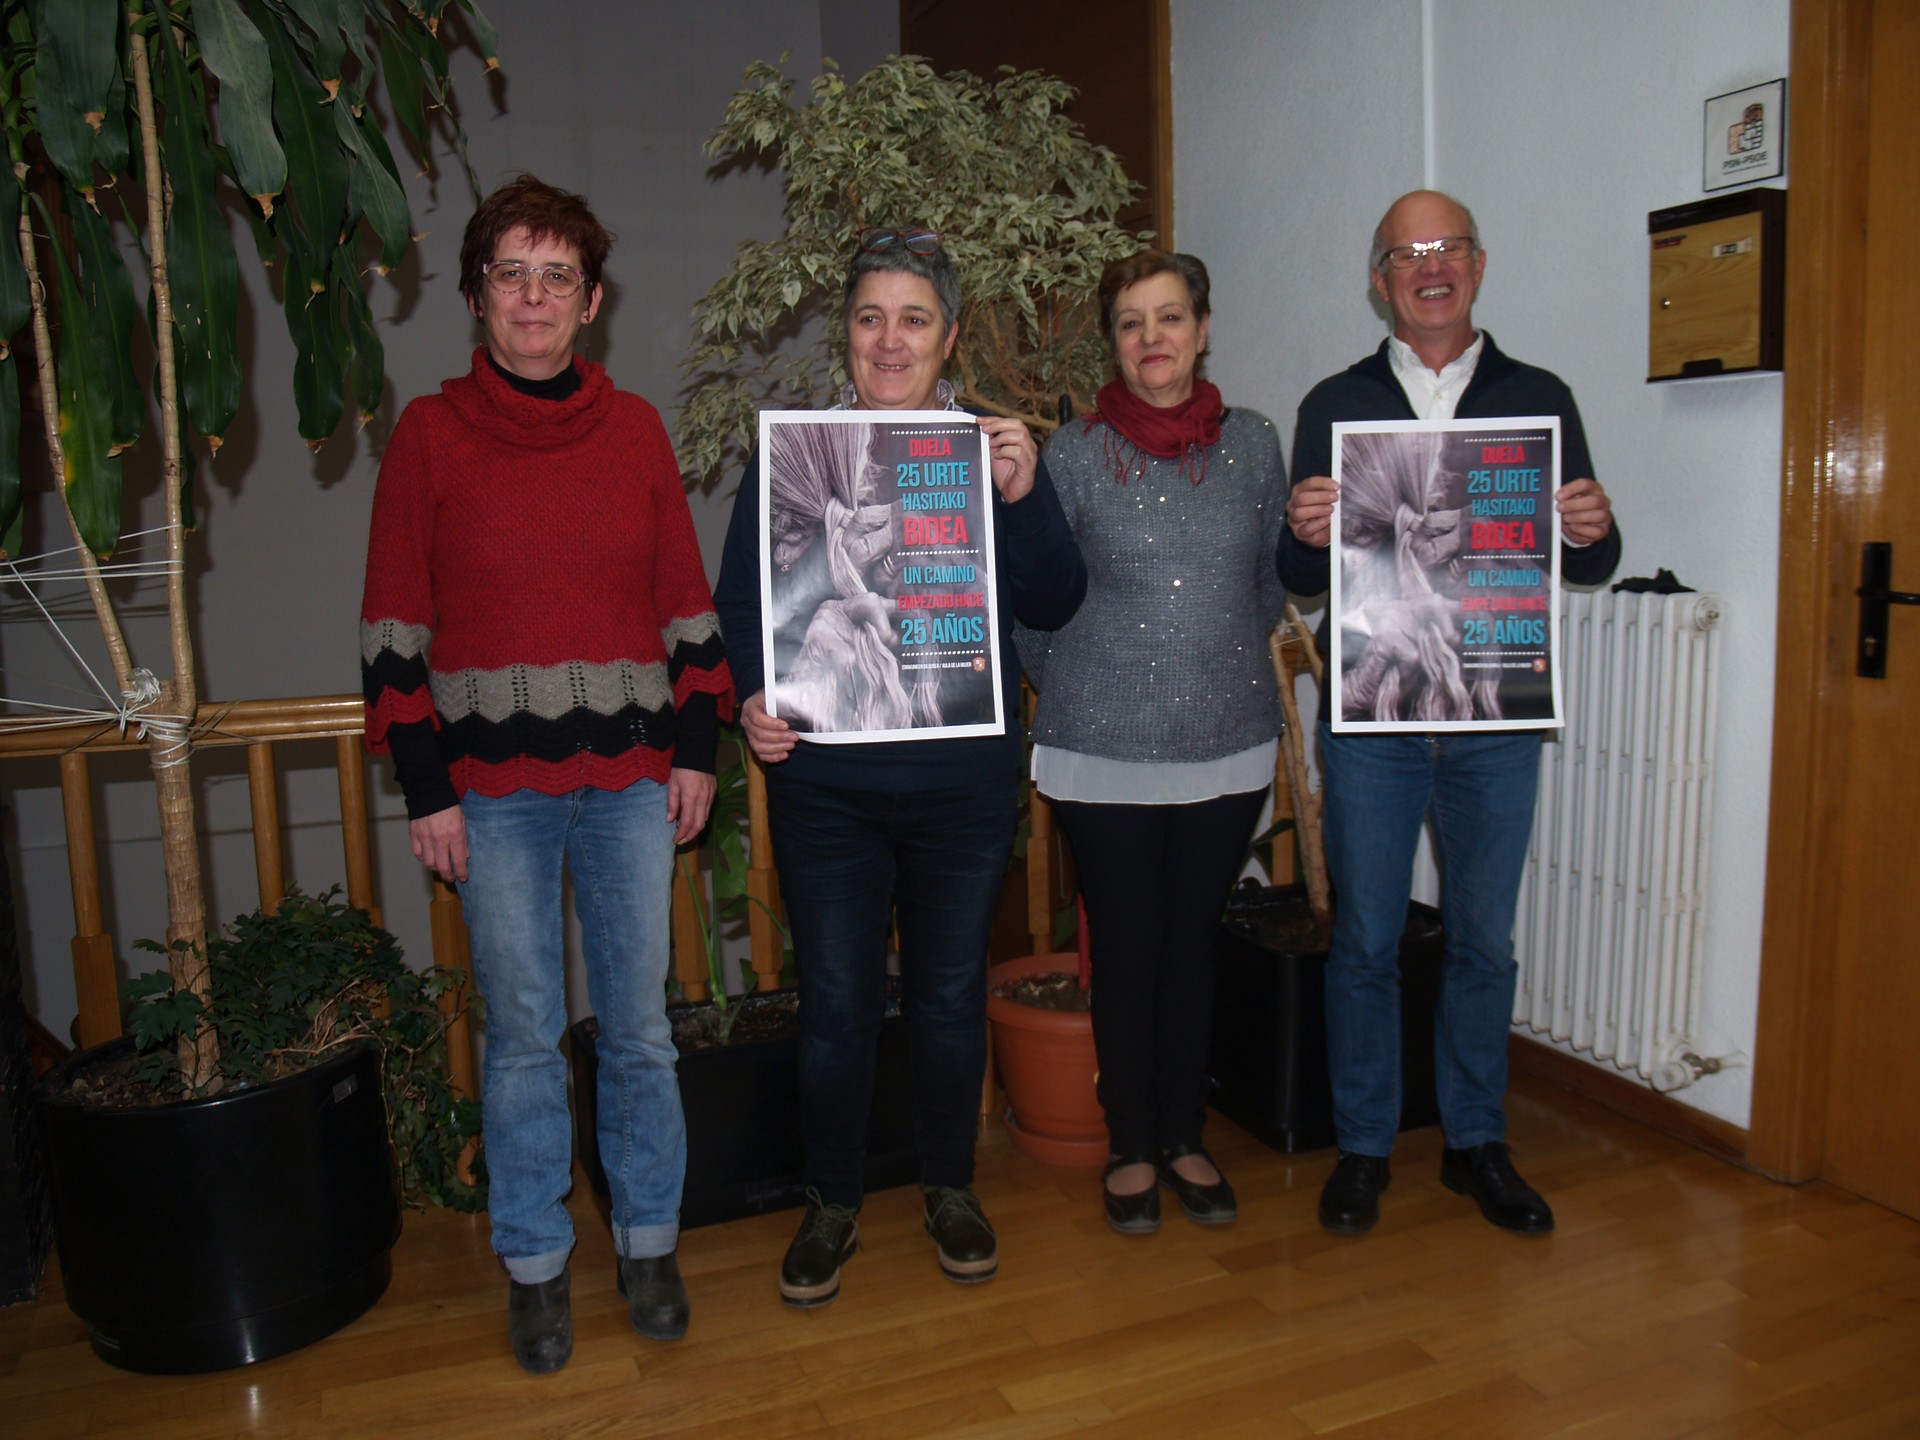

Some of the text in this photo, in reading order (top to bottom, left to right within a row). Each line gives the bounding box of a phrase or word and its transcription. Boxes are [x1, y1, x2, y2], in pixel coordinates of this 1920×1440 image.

[1722, 151, 1768, 169] PSN-PSOE
[909, 437, 952, 457] DUELA
[1481, 445, 1525, 465] DUELA
[897, 461, 970, 487] 25 URTE
[1467, 468, 1541, 493] 25 URTE
[903, 491, 967, 511] HASITAKO
[1471, 498, 1536, 517] HASITAKO
[903, 515, 968, 546] BIDEA
[1471, 521, 1536, 549] BIDEA
[903, 565, 976, 585] UN CAMINO
[1468, 568, 1540, 588] UN CAMINO
[898, 593, 984, 610] EMPEZADO HACE
[901, 613, 984, 645] 25 AÑOS
[1463, 615, 1546, 645] 25 AÑOS
